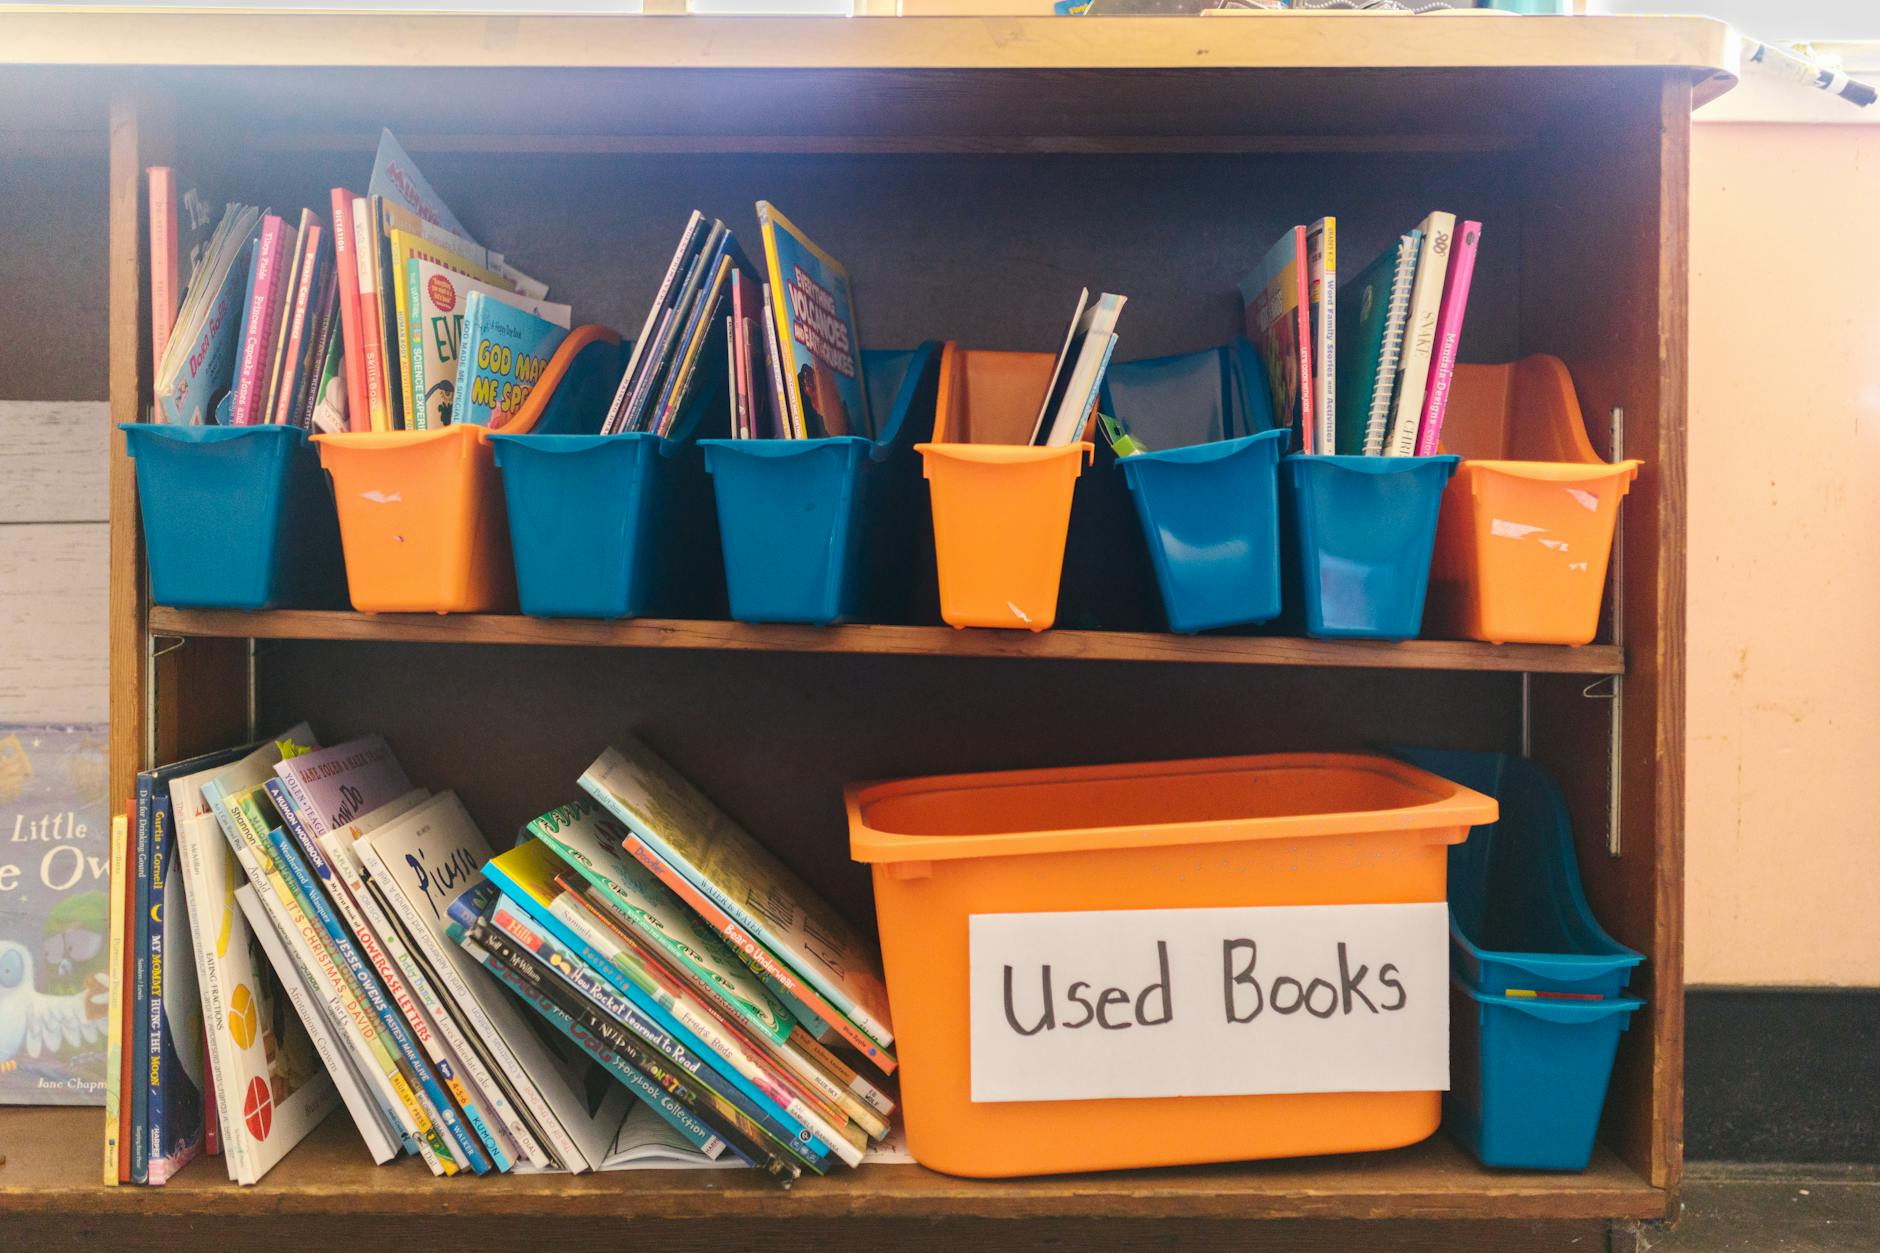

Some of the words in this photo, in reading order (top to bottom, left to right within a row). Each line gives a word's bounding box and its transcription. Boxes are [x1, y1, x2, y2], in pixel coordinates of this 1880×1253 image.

[335, 209, 345, 251] DICTATION
[249, 295, 264, 335] Princess
[462, 320, 471, 340] GOD
[787, 279, 849, 353] VOLCANOES
[1326, 308, 1334, 340] Family
[1414, 311, 1435, 359] SNAKE
[242, 337, 257, 376] Cupcake
[413, 348, 424, 391] SCIENCE
[459, 342, 468, 368] MADE
[478, 339, 511, 376] GOD
[1438, 333, 1456, 379] Mandala
[238, 378, 251, 405] Jones
[309, 374, 319, 394] THEIR
[458, 370, 465, 384] ME
[472, 375, 499, 410] ME
[235, 407, 246, 424] and
[302, 395, 315, 429] GREATEST
[453, 386, 463, 422] SPECIAL
[1428, 382, 1446, 425] Designs
[283, 772, 307, 803] YOLEN
[299, 766, 321, 784] JANE
[319, 760, 342, 778] YOLEN
[271, 787, 282, 797] A
[339, 784, 364, 813] Do
[139, 804, 148, 817] for
[154, 811, 165, 842] Curtis
[230, 806, 258, 846] Shannon
[276, 795, 300, 826] KUMON
[10, 812, 88, 842] Little
[137, 818, 148, 852] Drinking
[249, 816, 274, 851] Milord
[294, 824, 325, 868] WORKBOOK
[634, 845, 667, 876] Doodler
[138, 854, 147, 877] Gourd
[153, 853, 165, 890] Cornell
[247, 863, 272, 895] Arnold
[376, 870, 391, 886] Bell
[277, 841, 309, 885] Weatherford
[306, 889, 333, 924] Velasquez
[329, 847, 356, 880] KAPLAN
[357, 891, 384, 925] JORISCH
[405, 848, 478, 922] Picasso
[328, 881, 340, 893] My
[334, 890, 349, 907] First
[343, 904, 357, 921] Book
[352, 919, 363, 929] of
[391, 892, 416, 922] Chanda
[699, 877, 730, 906] WATER
[733, 908, 764, 936] WATER
[309, 914, 339, 958] HAPPY
[409, 918, 425, 936] and
[505, 919, 536, 946] Hills
[560, 909, 594, 940] Samuels
[152, 935, 161, 952] MY
[418, 932, 450, 972] Aebersold
[485, 934, 504, 952] Noll
[723, 922, 750, 948] Bear
[751, 947, 798, 990] Underwear
[151, 954, 161, 996] MOMMY
[205, 952, 218, 982] EATING
[286, 898, 308, 925] IT'S
[301, 924, 351, 999] CHRISTMAS,
[346, 1000, 378, 1044] DAVID!
[355, 925, 405, 995] LOWERCASE
[396, 992, 435, 1043] LETTERS
[449, 978, 468, 999] Carol
[690, 973, 714, 994] DOG
[1003, 940, 1175, 1039] Used
[1223, 936, 1408, 1026] Books
[151, 998, 160, 1029] HUNG
[210, 983, 225, 1031] FRACTIONS
[328, 995, 353, 1028] Parts
[334, 935, 363, 972] JESSE
[356, 970, 388, 1013] OWENS
[382, 1012, 405, 1041] FASTEST
[399, 1039, 417, 1060] MAN
[410, 1057, 431, 1083] ALIVE
[468, 1006, 495, 1039] Tradition
[568, 967, 594, 992] How
[588, 982, 628, 1018] Rocket
[622, 1009, 666, 1047] Learned
[660, 1037, 676, 1054] to
[670, 1045, 702, 1074] Read
[151, 1031, 160, 1053] THE
[680, 1011, 712, 1040] Fred's
[709, 1036, 736, 1060] Beds
[315, 1036, 342, 1073] Crowns
[438, 1015, 459, 1039] Loves
[451, 1035, 482, 1073] Chocolate
[474, 1069, 493, 1091] Cake
[489, 1036, 520, 1075] Christmas
[38, 1077, 64, 1089] Jane
[150, 1055, 160, 1086] MOON
[565, 1019, 616, 1065] Cat
[611, 1055, 662, 1101] Storybook
[659, 1095, 709, 1140] Collection
[637, 1055, 700, 1108] MONSTER
[451, 1081, 470, 1105] 4-5-6
[522, 1085, 542, 1109] Shelf
[814, 1076, 829, 1090] BLUE
[826, 1086, 839, 1098] SKY
[864, 1093, 880, 1107] WOLF
[536, 1106, 550, 1120] the
[545, 1117, 556, 1128] on
[152, 1128, 161, 1158] HARPER
[451, 1124, 476, 1157] WALKER
[521, 1136, 539, 1157] DIAL
[550, 1126, 564, 1140] Elf
[558, 1137, 573, 1154] The
